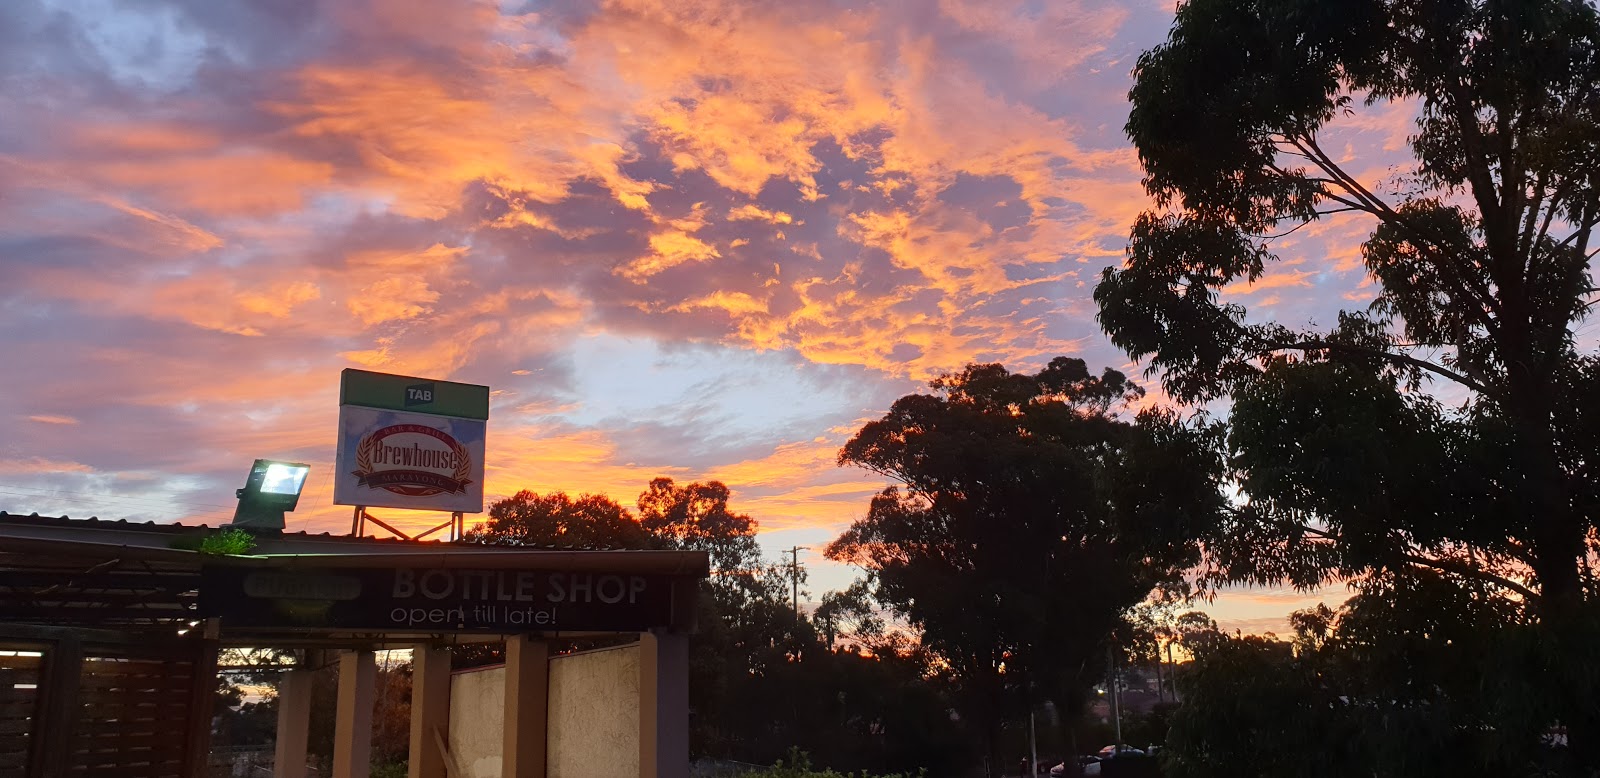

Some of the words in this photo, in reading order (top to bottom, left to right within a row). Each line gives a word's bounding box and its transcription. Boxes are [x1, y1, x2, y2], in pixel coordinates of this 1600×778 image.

[407, 388, 432, 401] TAB
[384, 426, 405, 435] BAR
[418, 426, 446, 440] GRILL
[372, 439, 457, 470] Brewhouse
[383, 474, 444, 485] MARAYONG
[392, 568, 535, 602] BOTTLE
[546, 572, 647, 604] SHOP
[390, 607, 465, 627] open
[473, 605, 496, 623] till
[504, 606, 556, 625] late!
